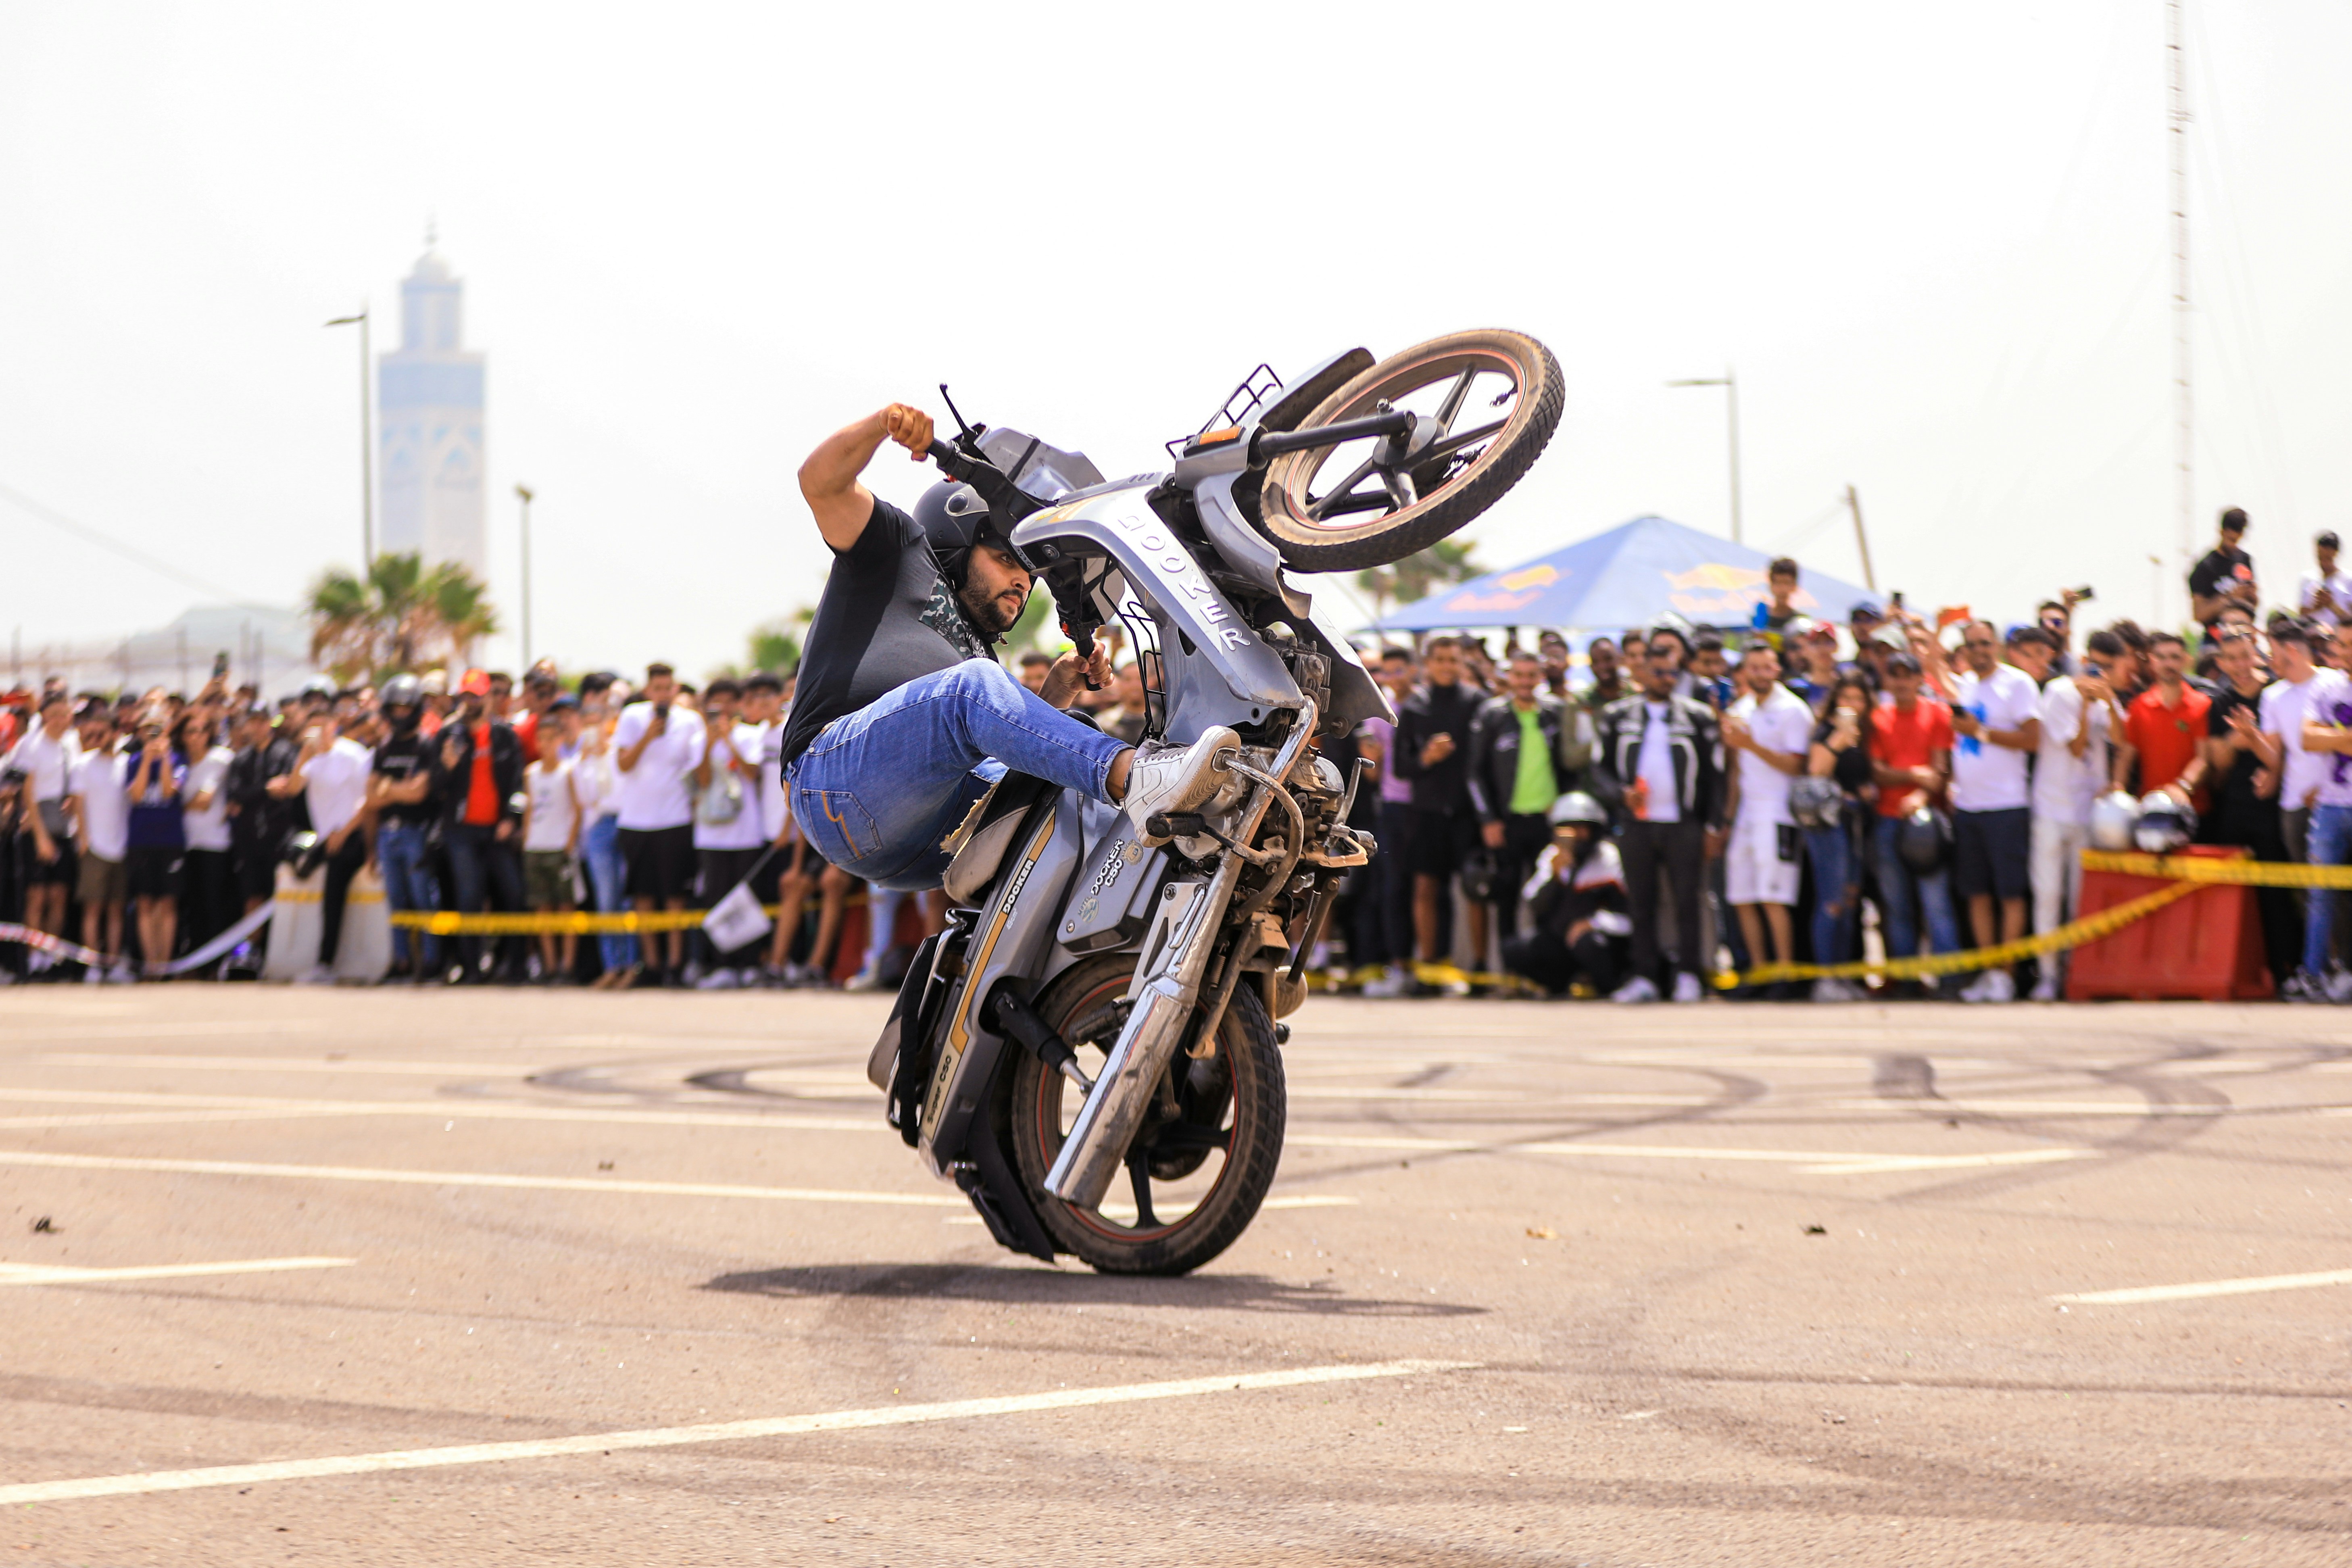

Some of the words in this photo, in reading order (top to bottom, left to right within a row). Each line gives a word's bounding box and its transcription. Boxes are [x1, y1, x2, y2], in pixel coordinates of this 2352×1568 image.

[1117, 515, 1251, 651] DOCKER
[1003, 859, 1034, 914] DOCKER
[1090, 838, 1124, 896] DOCKER
[1105, 859, 1124, 887] C50
[927, 1084, 941, 1125] Super
[940, 1055, 951, 1082] C50
